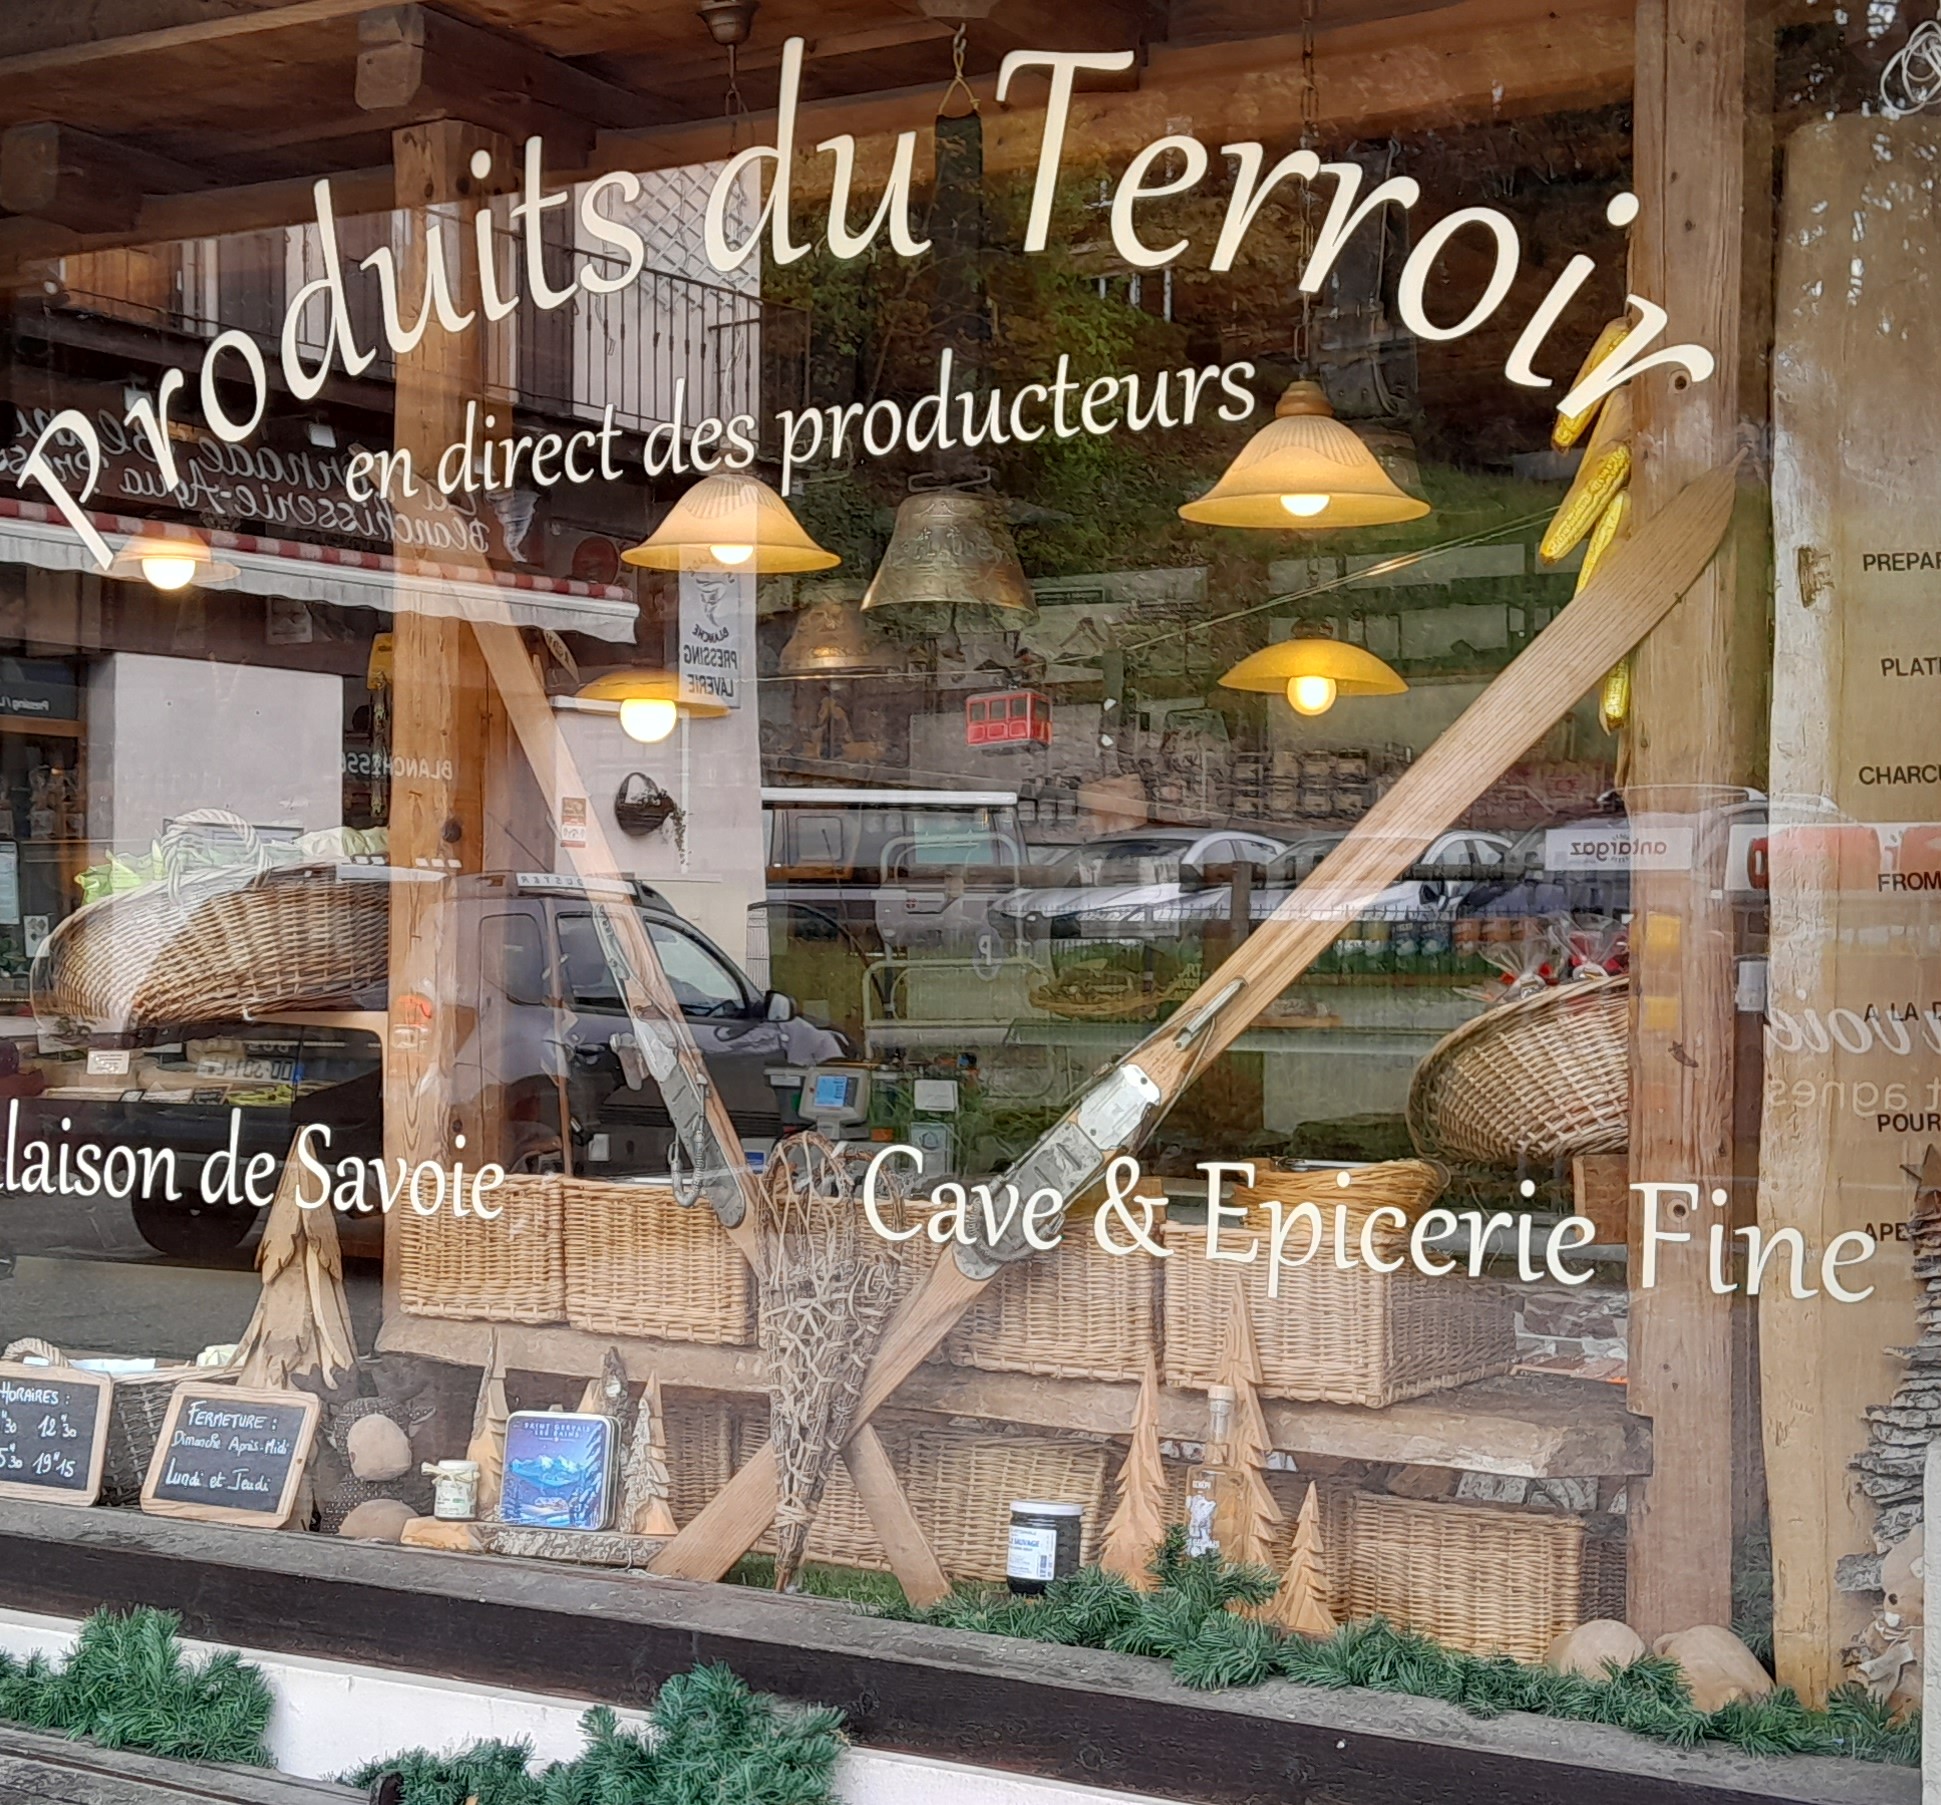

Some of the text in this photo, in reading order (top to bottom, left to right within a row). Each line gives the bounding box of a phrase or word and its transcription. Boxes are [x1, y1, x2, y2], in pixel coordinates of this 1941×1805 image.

[17, 36, 1715, 571] Produits du Terroir
[346, 346, 1256, 502] en direct des producteurs
[0, 1098, 505, 1220] laison de Savoie
[1877, 1112, 1941, 1132] POUR
[862, 1144, 1877, 1304] Cave & Epicerie Fine
[171, 1429, 222, 1449] Dimanche
[188, 1400, 268, 1430] FERMETURE
[165, 1457, 271, 1492] Lundi et Jeudi
